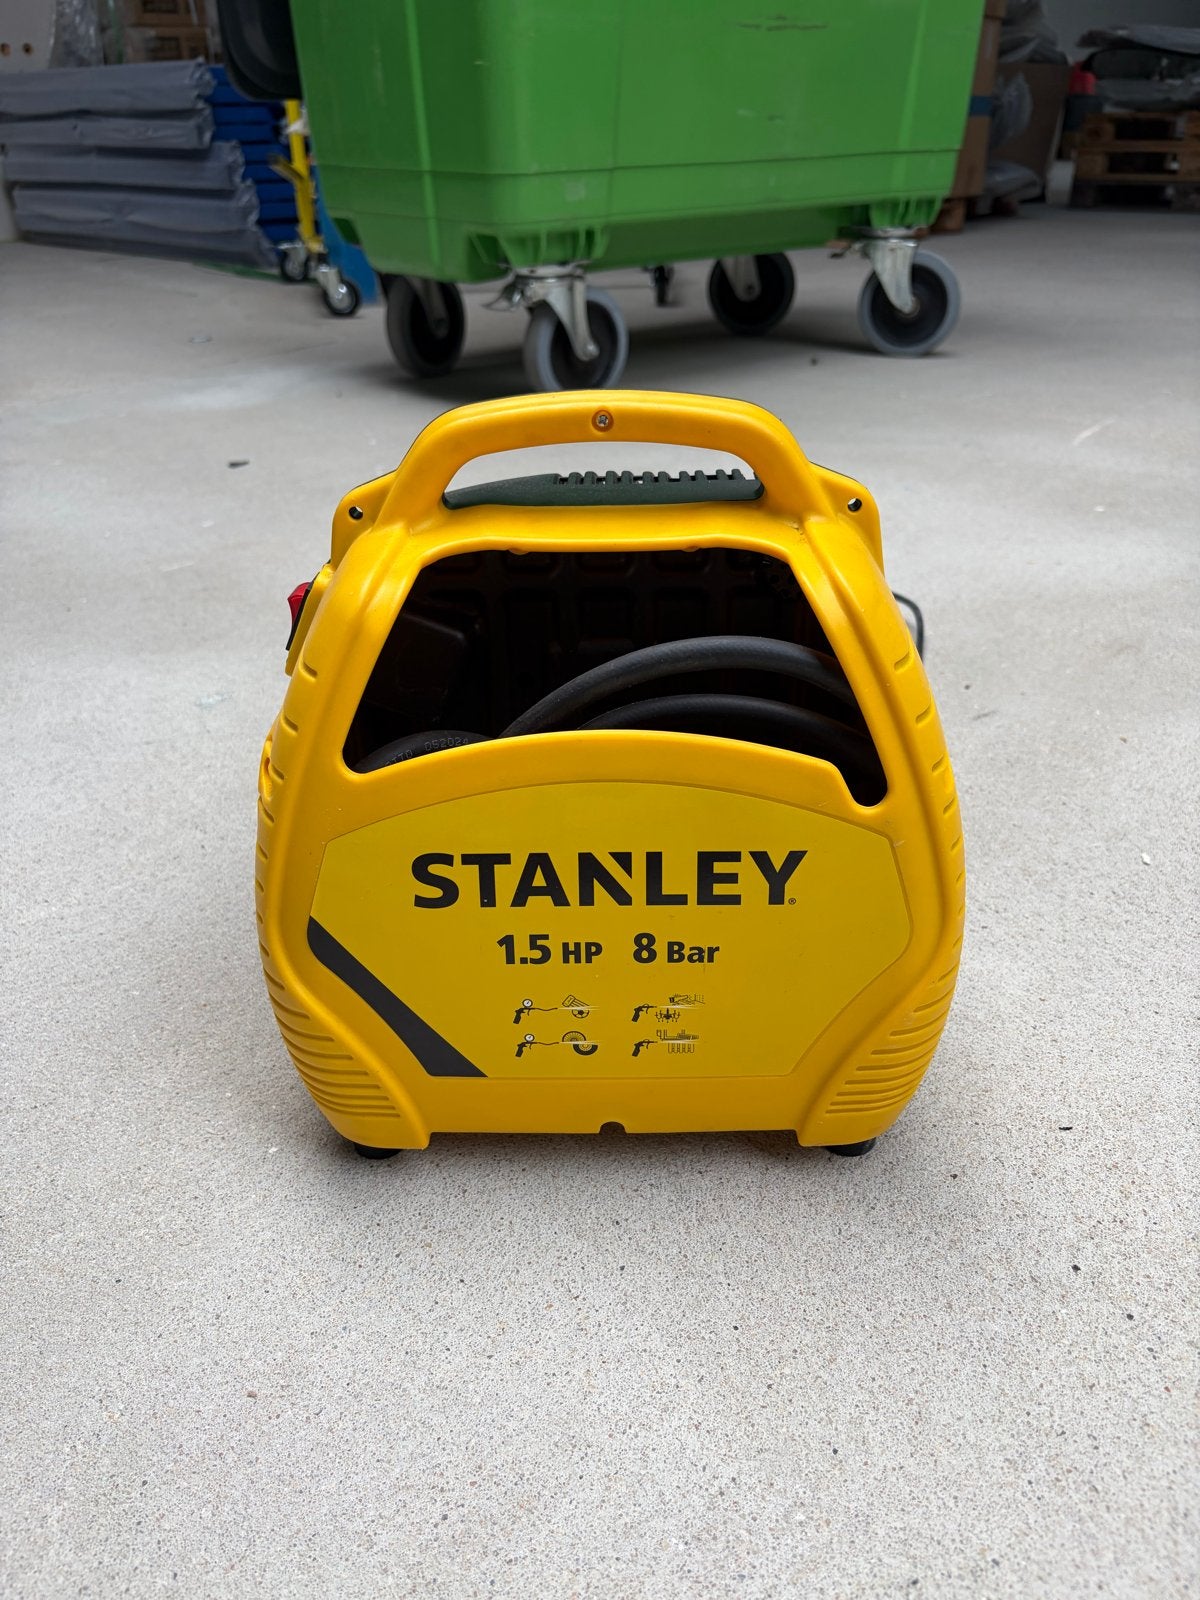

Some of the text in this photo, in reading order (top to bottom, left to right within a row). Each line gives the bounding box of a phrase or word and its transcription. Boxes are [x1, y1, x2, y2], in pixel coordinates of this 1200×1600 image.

[411, 850, 808, 908] STANLEY
[496, 932, 720, 965] 1.5 HP 8 Bar
